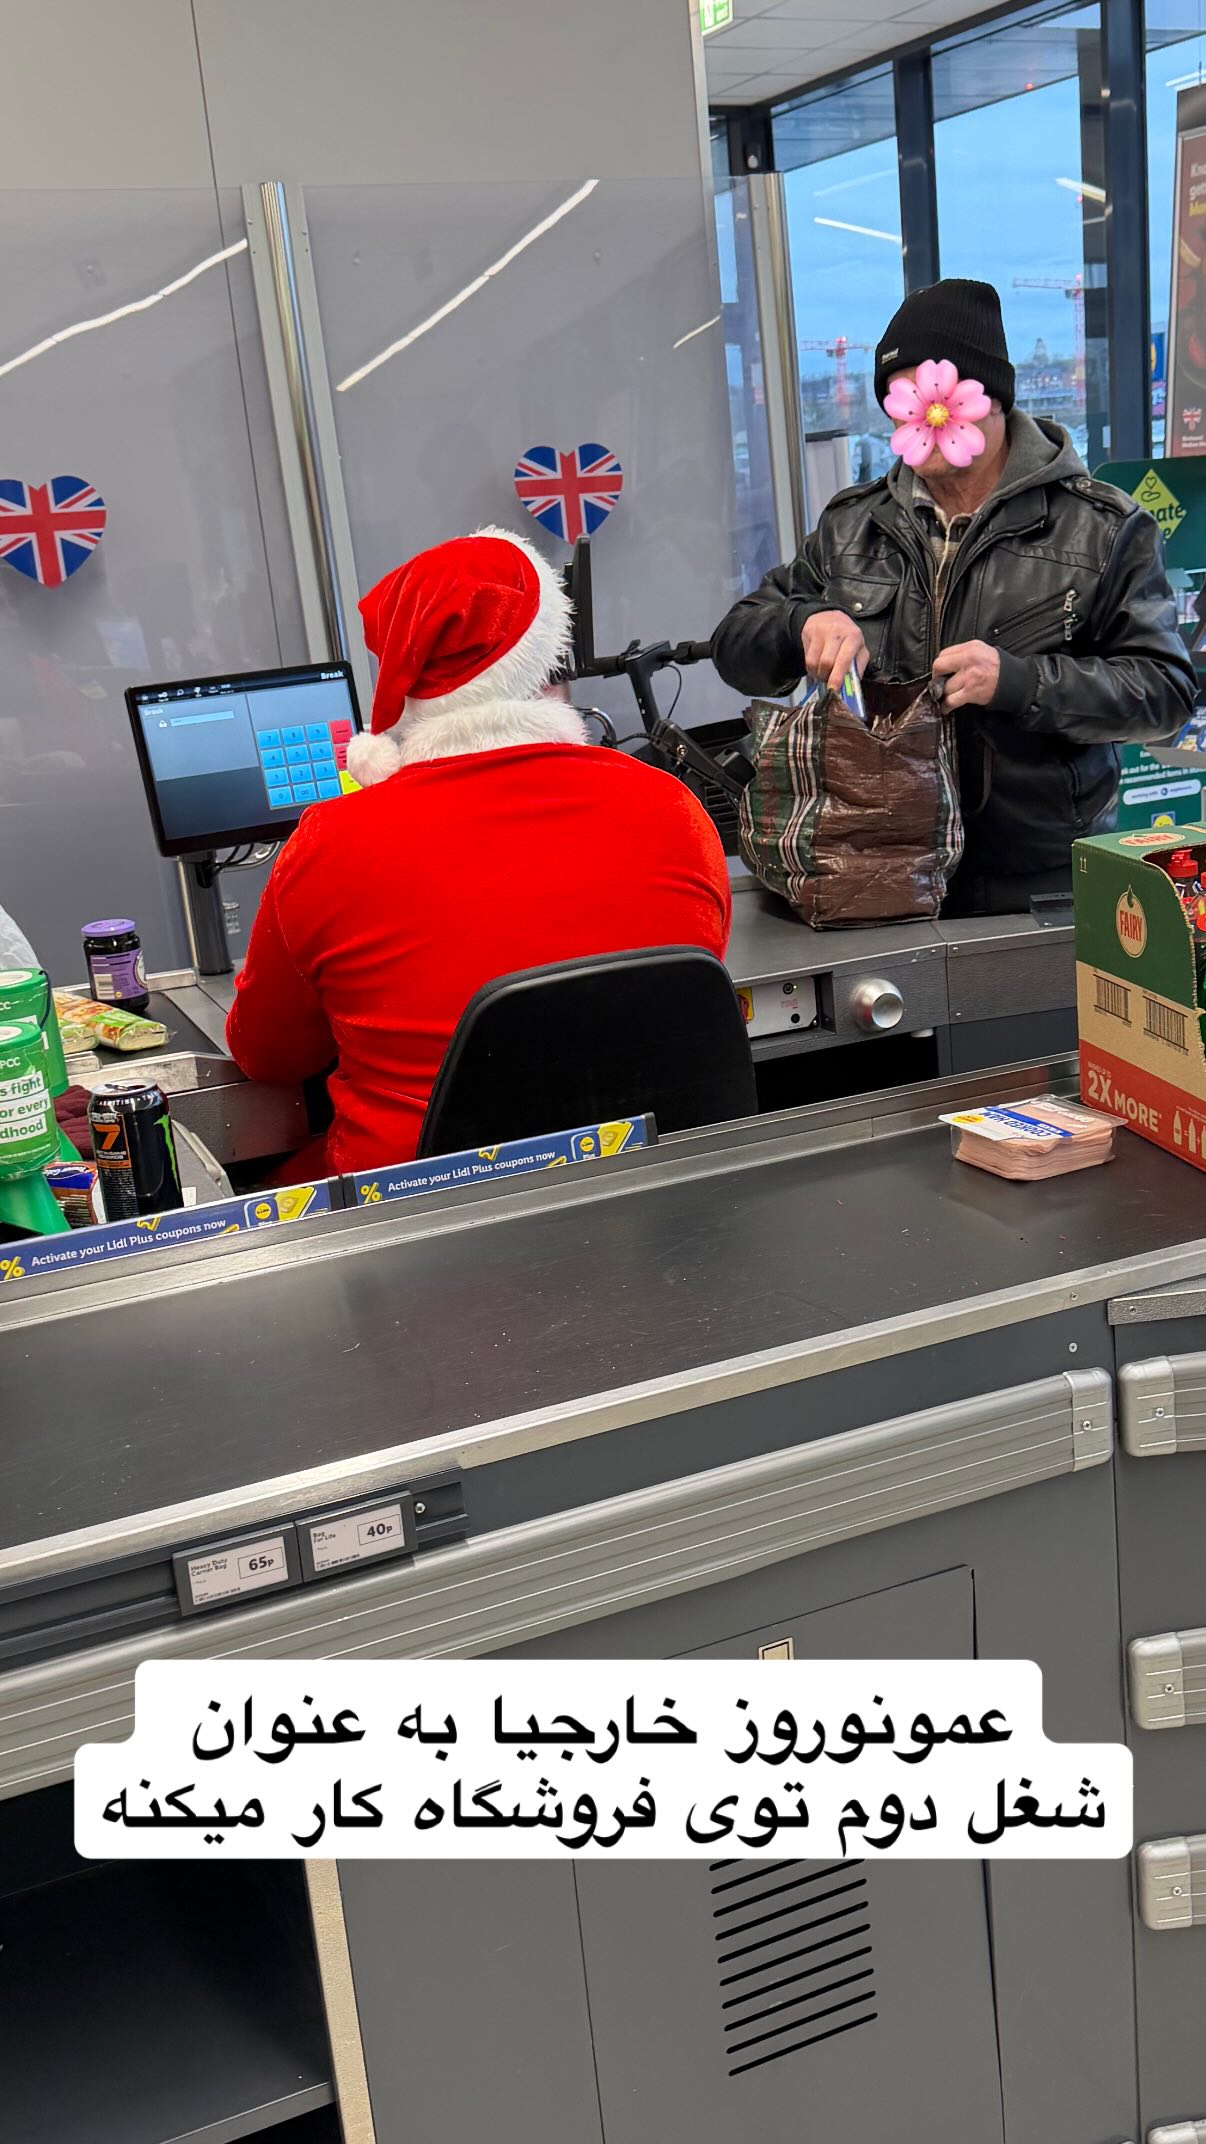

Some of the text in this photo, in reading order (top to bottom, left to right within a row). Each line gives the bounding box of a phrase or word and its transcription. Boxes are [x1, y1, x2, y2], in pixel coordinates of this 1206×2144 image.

[320, 670, 344, 680] Break
[1119, 910, 1142, 942] FAIRY
[11, 1079, 42, 1096] fight
[18, 1098, 49, 1117] every
[1087, 1069, 1113, 1108] 2X
[1114, 1089, 1159, 1133] MORE
[0, 1119, 43, 1139] dhood
[93, 1123, 121, 1150] 7
[388, 1175, 428, 1192] Activate
[429, 1171, 451, 1186] your
[452, 1166, 471, 1179] Lidl
[472, 1162, 493, 1175] Plus
[494, 1154, 534, 1172] coupons
[535, 1150, 556, 1162] now
[31, 1249, 78, 1267] Activate
[78, 1244, 105, 1260] your
[107, 1236, 128, 1252] Lidl
[129, 1232, 154, 1247] Plus
[155, 1223, 202, 1242] coupons
[203, 1218, 226, 1232] now
[366, 1522, 393, 1538] 40p
[248, 1555, 274, 1572] 65p
